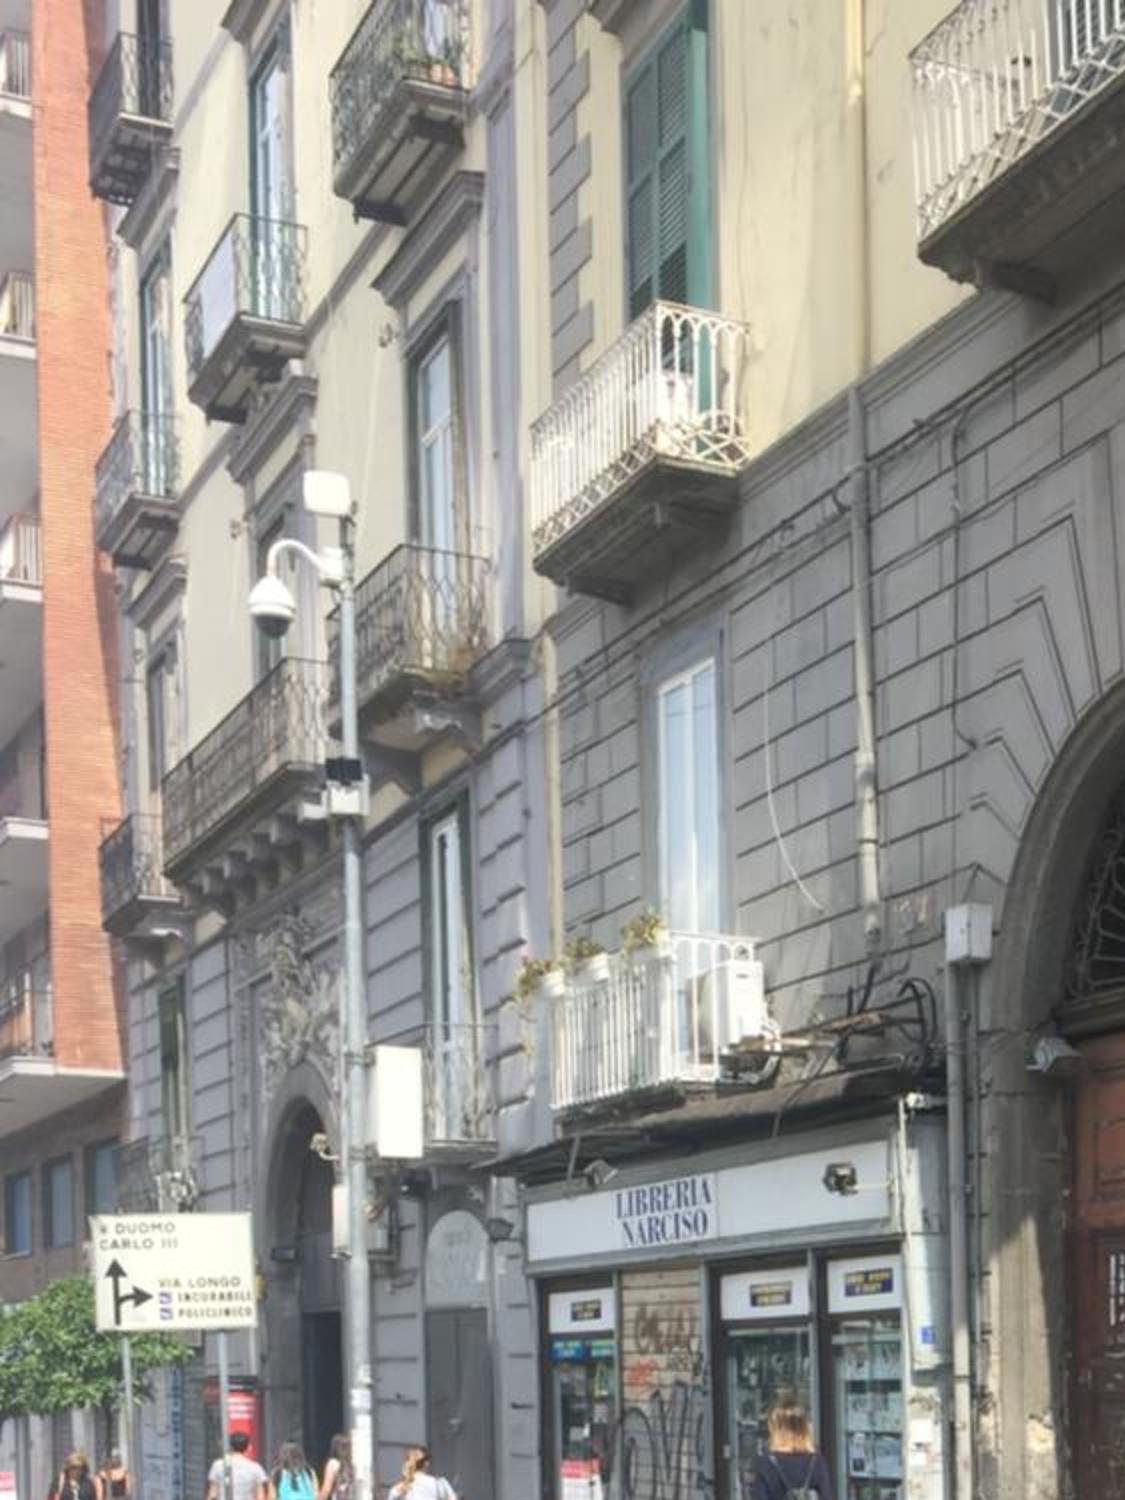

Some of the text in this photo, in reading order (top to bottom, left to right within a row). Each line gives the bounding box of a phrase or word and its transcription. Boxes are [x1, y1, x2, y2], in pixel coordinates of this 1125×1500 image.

[615, 1177, 711, 1220] LIBRERIA
[114, 1221, 176, 1236] DUOMO
[622, 1207, 708, 1247] NARCISO
[99, 1236, 179, 1251] CARLO III
[158, 1276, 241, 1290] VIA LONGO
